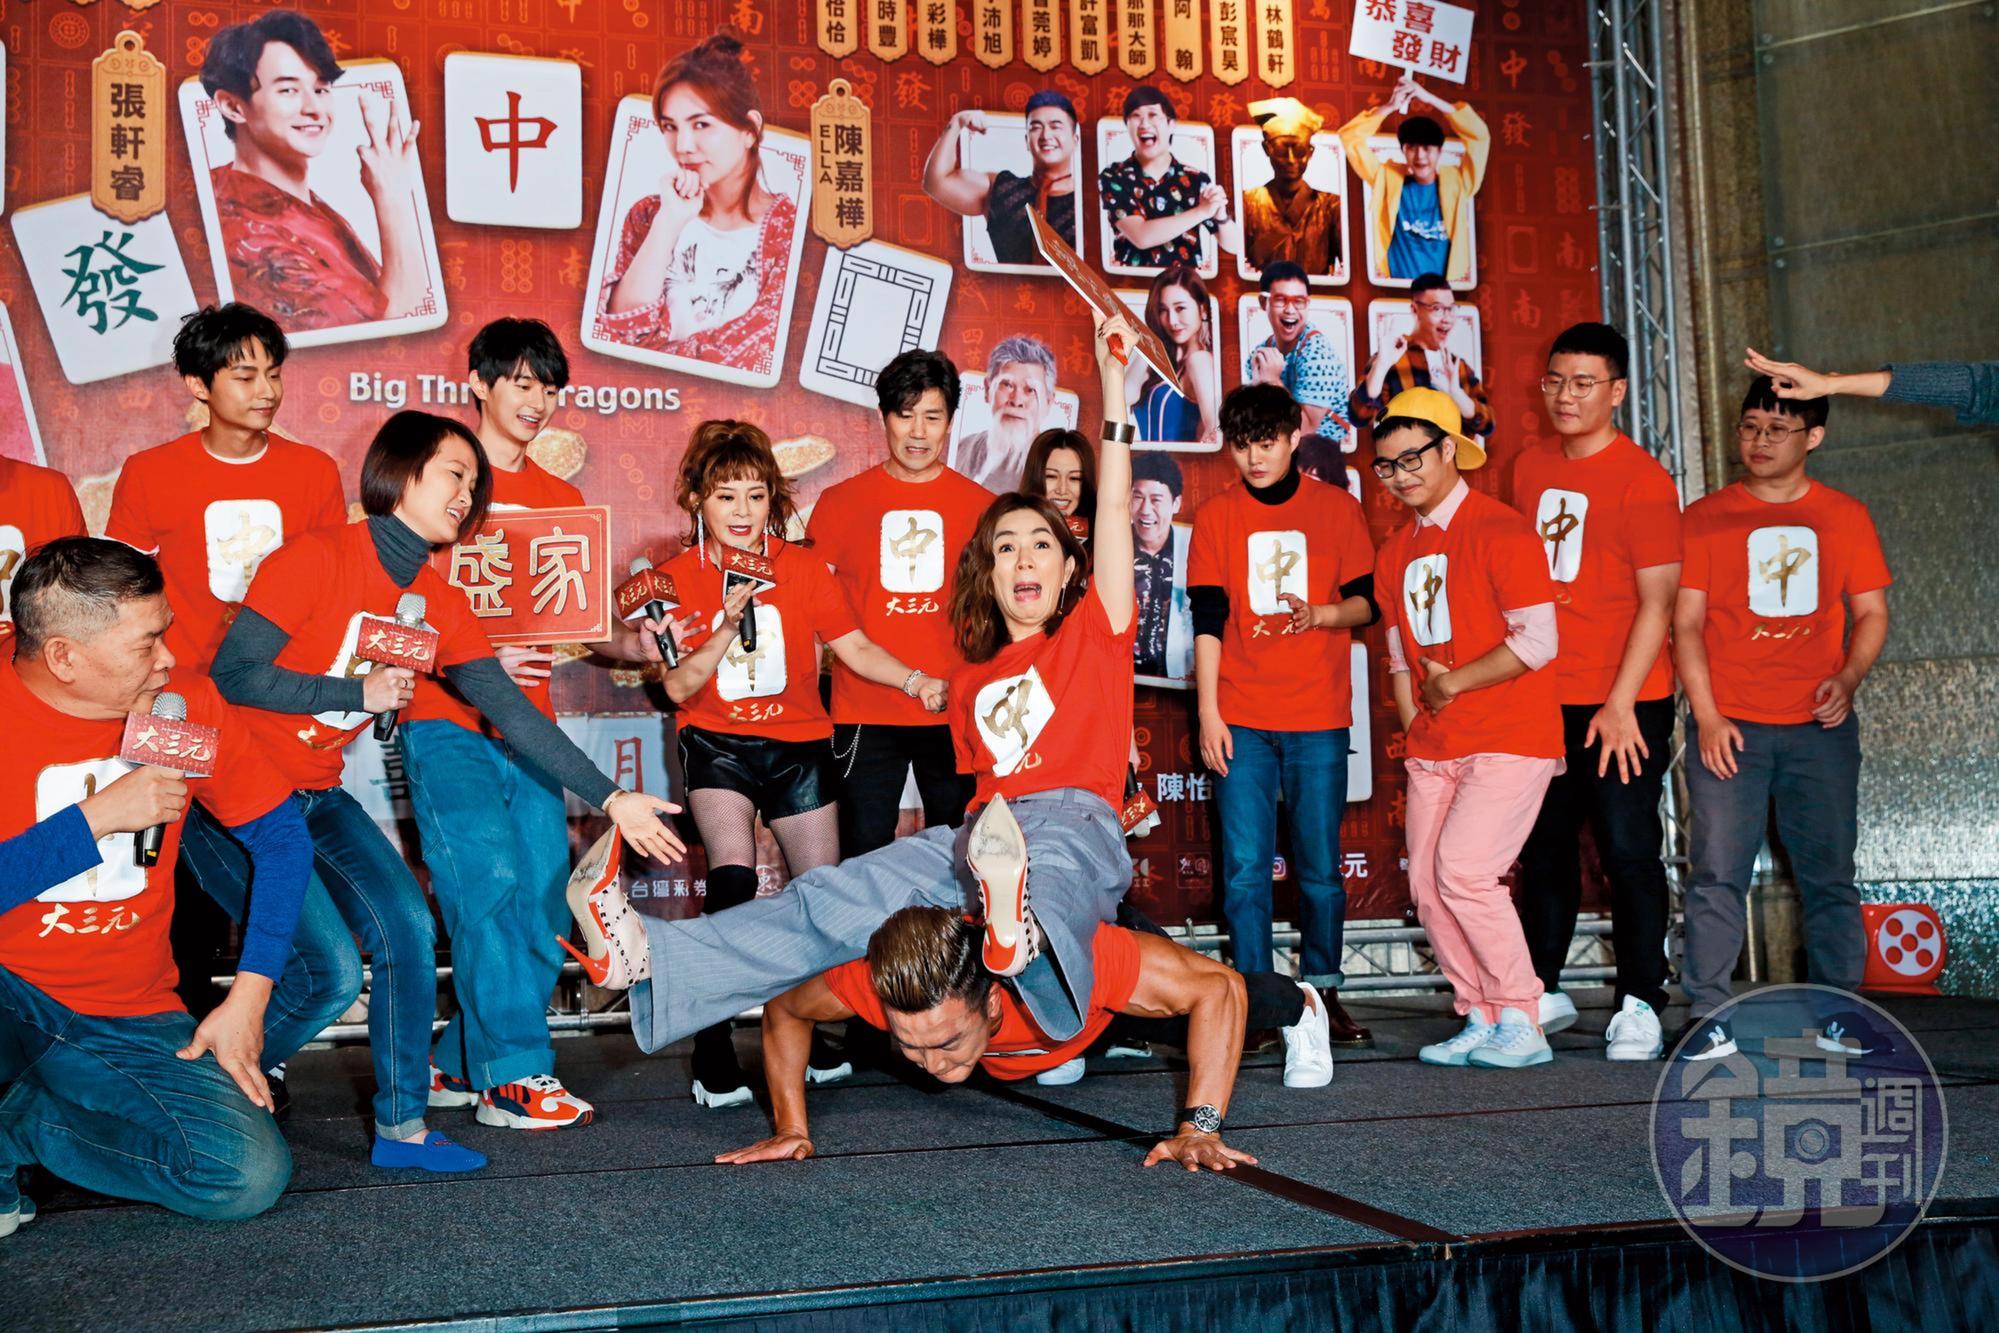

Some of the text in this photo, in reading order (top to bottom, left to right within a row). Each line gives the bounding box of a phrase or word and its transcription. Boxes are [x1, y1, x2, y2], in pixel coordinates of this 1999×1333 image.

[982, 0, 1003, 54] 沛旭
[1265, 7, 1285, 74] 林鶴軒
[1393, 30, 1462, 73] 發財
[110, 83, 146, 201] 張軒睿
[474, 91, 558, 194] 中
[819, 124, 833, 184] ELLA
[834, 124, 865, 230] 陳嘉樺
[60, 230, 166, 336] 發
[349, 372, 407, 408] Big
[416, 374, 474, 404] Thr
[557, 384, 682, 414] ragons
[730, 552, 773, 576] 大三元
[889, 516, 938, 585] 中
[1541, 497, 1579, 571] 中
[1255, 538, 1302, 606] 中
[1758, 534, 1813, 608] 中
[885, 596, 940, 617] 大三元
[365, 629, 430, 661] 大三元
[132, 725, 212, 762] 大三元
[38, 902, 141, 938] 大三元
